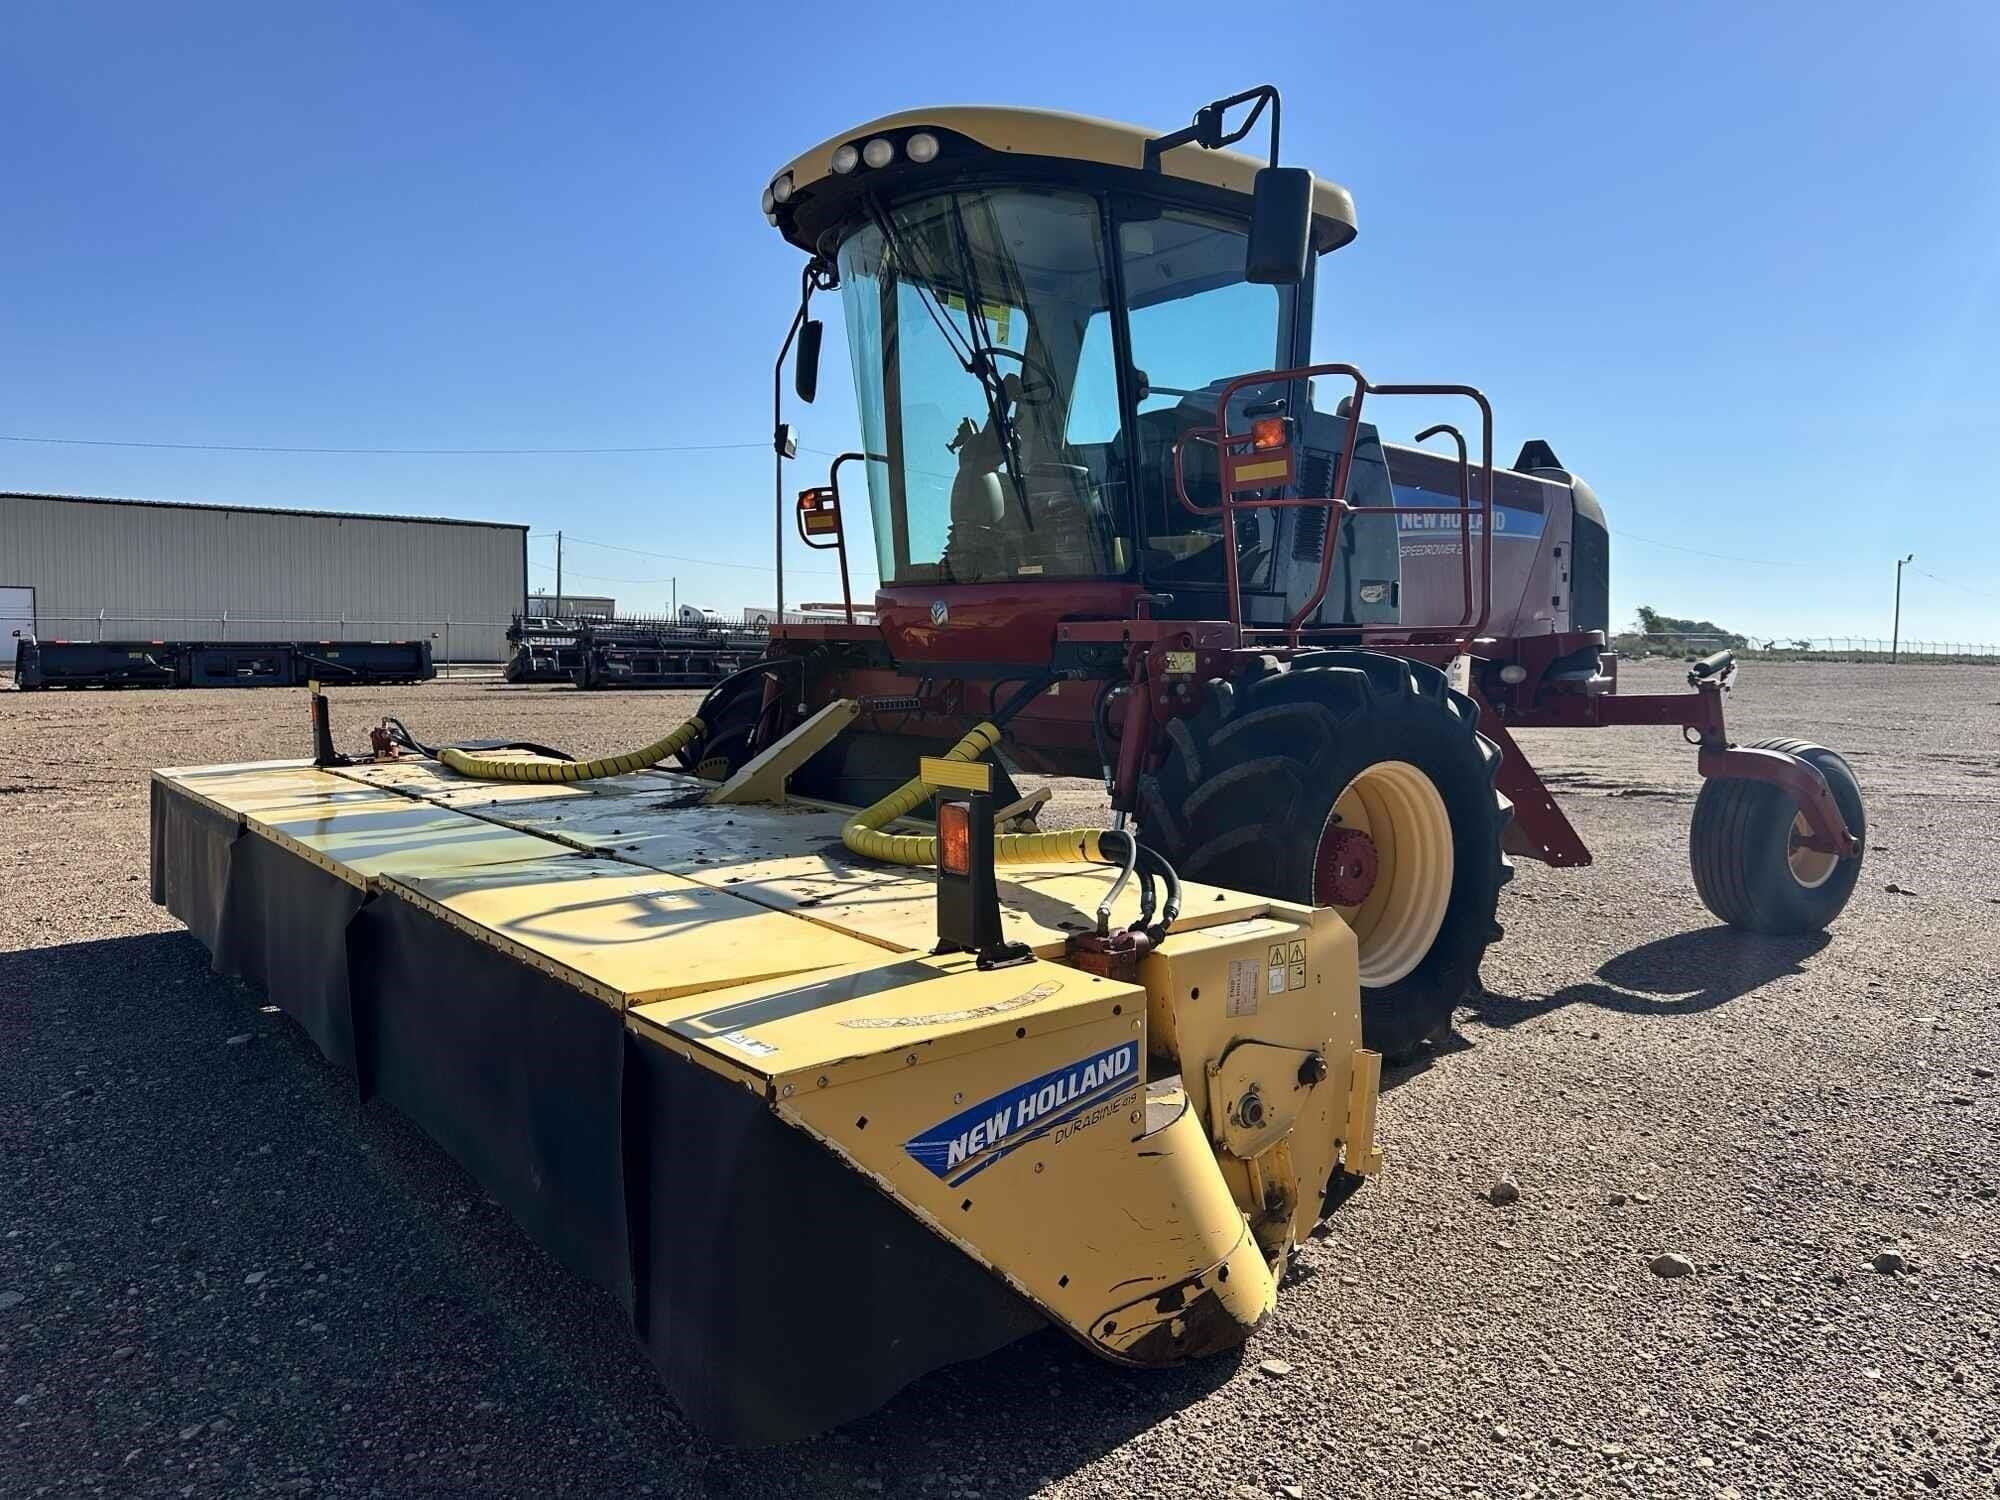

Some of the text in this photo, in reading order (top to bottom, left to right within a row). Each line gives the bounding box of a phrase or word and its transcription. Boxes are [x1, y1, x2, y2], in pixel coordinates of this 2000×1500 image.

[1402, 512, 1506, 530] NEW HOLAD
[947, 1047, 1131, 1170] NEW HOLLAND
[1055, 1097, 1122, 1145] DURABINE
